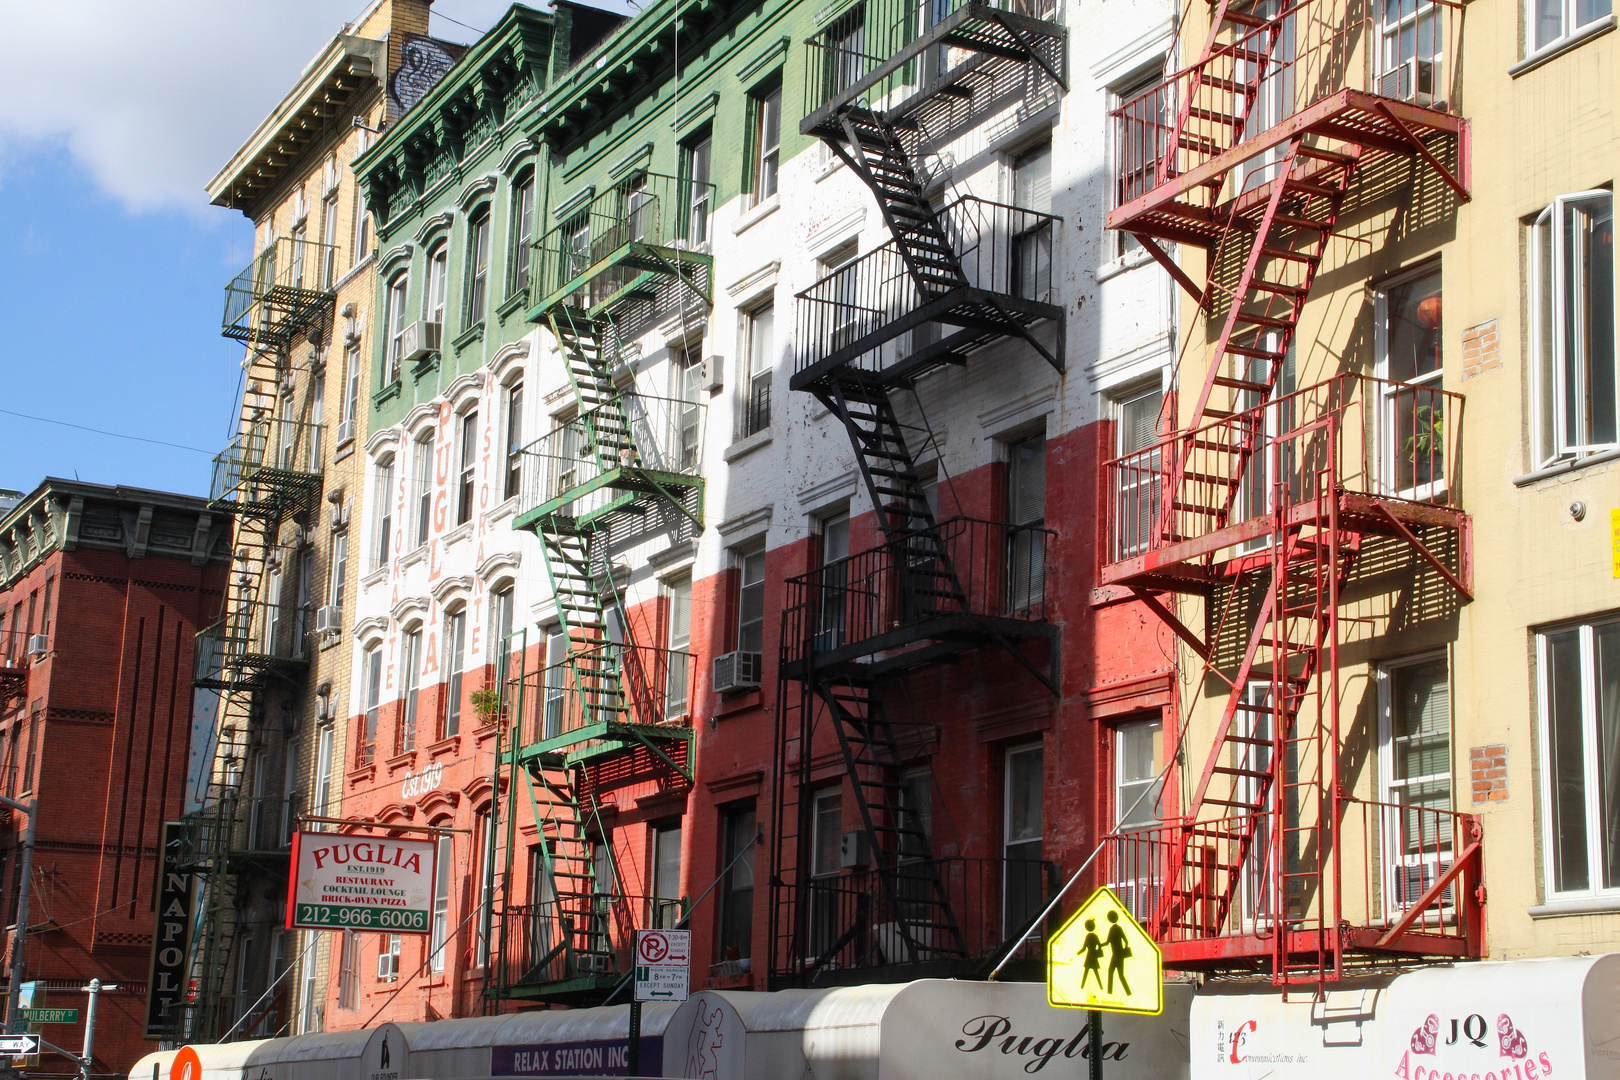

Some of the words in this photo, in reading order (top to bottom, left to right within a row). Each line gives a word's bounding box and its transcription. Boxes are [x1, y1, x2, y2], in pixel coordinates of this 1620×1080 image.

[472, 371, 495, 656] RISTORANTE
[421, 400, 452, 677] PUGLIA
[386, 427, 409, 690] RISTORANTE
[312, 843, 421, 875] PUGLIA
[323, 884, 369, 895] COCKTAIL
[370, 886, 406, 897] LOUNGE
[335, 876, 395, 887] RESTAURANT
[321, 895, 379, 905] BRICK-OVEN
[379, 897, 407, 906] PIZZA
[301, 906, 424, 928] 212-966-6006
[158, 872, 190, 1017] NAPOLI
[23, 1010, 66, 1022] MULBERRY
[12, 1041, 30, 1049] WAY
[514, 1050, 549, 1072] RELAX
[554, 1047, 603, 1070] STATION
